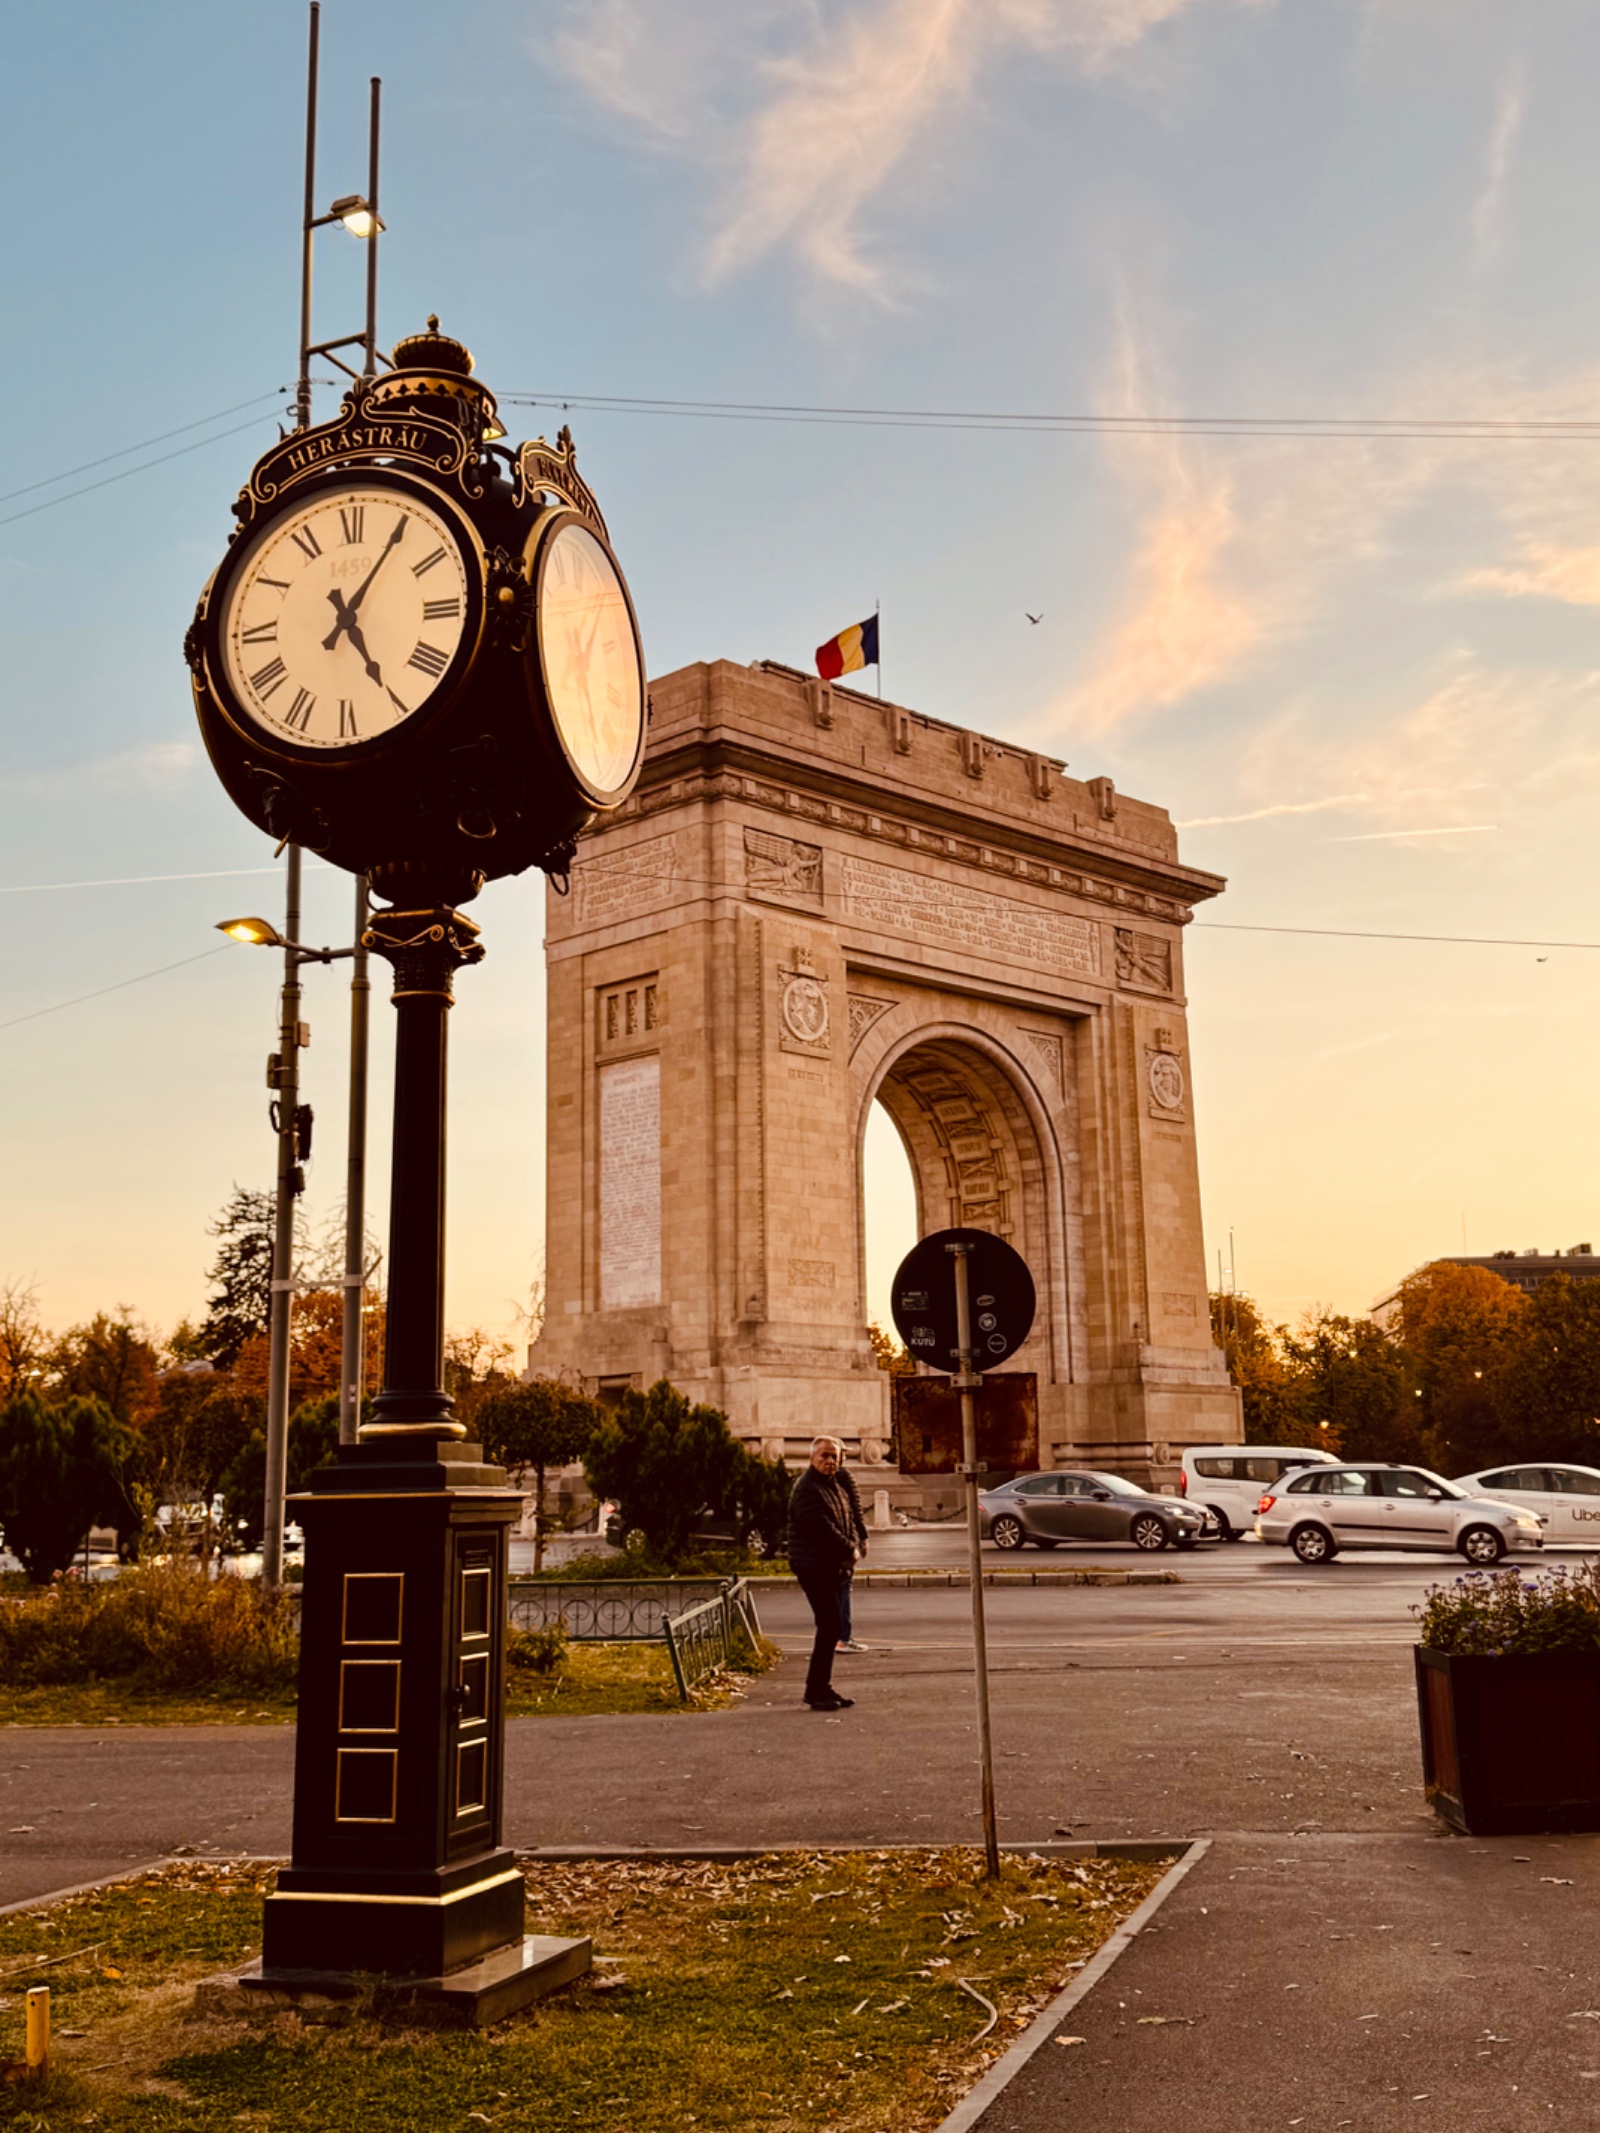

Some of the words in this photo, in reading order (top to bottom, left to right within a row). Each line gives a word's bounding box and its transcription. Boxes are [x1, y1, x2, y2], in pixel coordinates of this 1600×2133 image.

[288, 425, 427, 470] HERĂSTRĂU
[337, 504, 367, 547] XII
[329, 556, 372, 578] 1459
[422, 597, 460, 623] III
[1572, 1508, 1600, 1521] Ube
